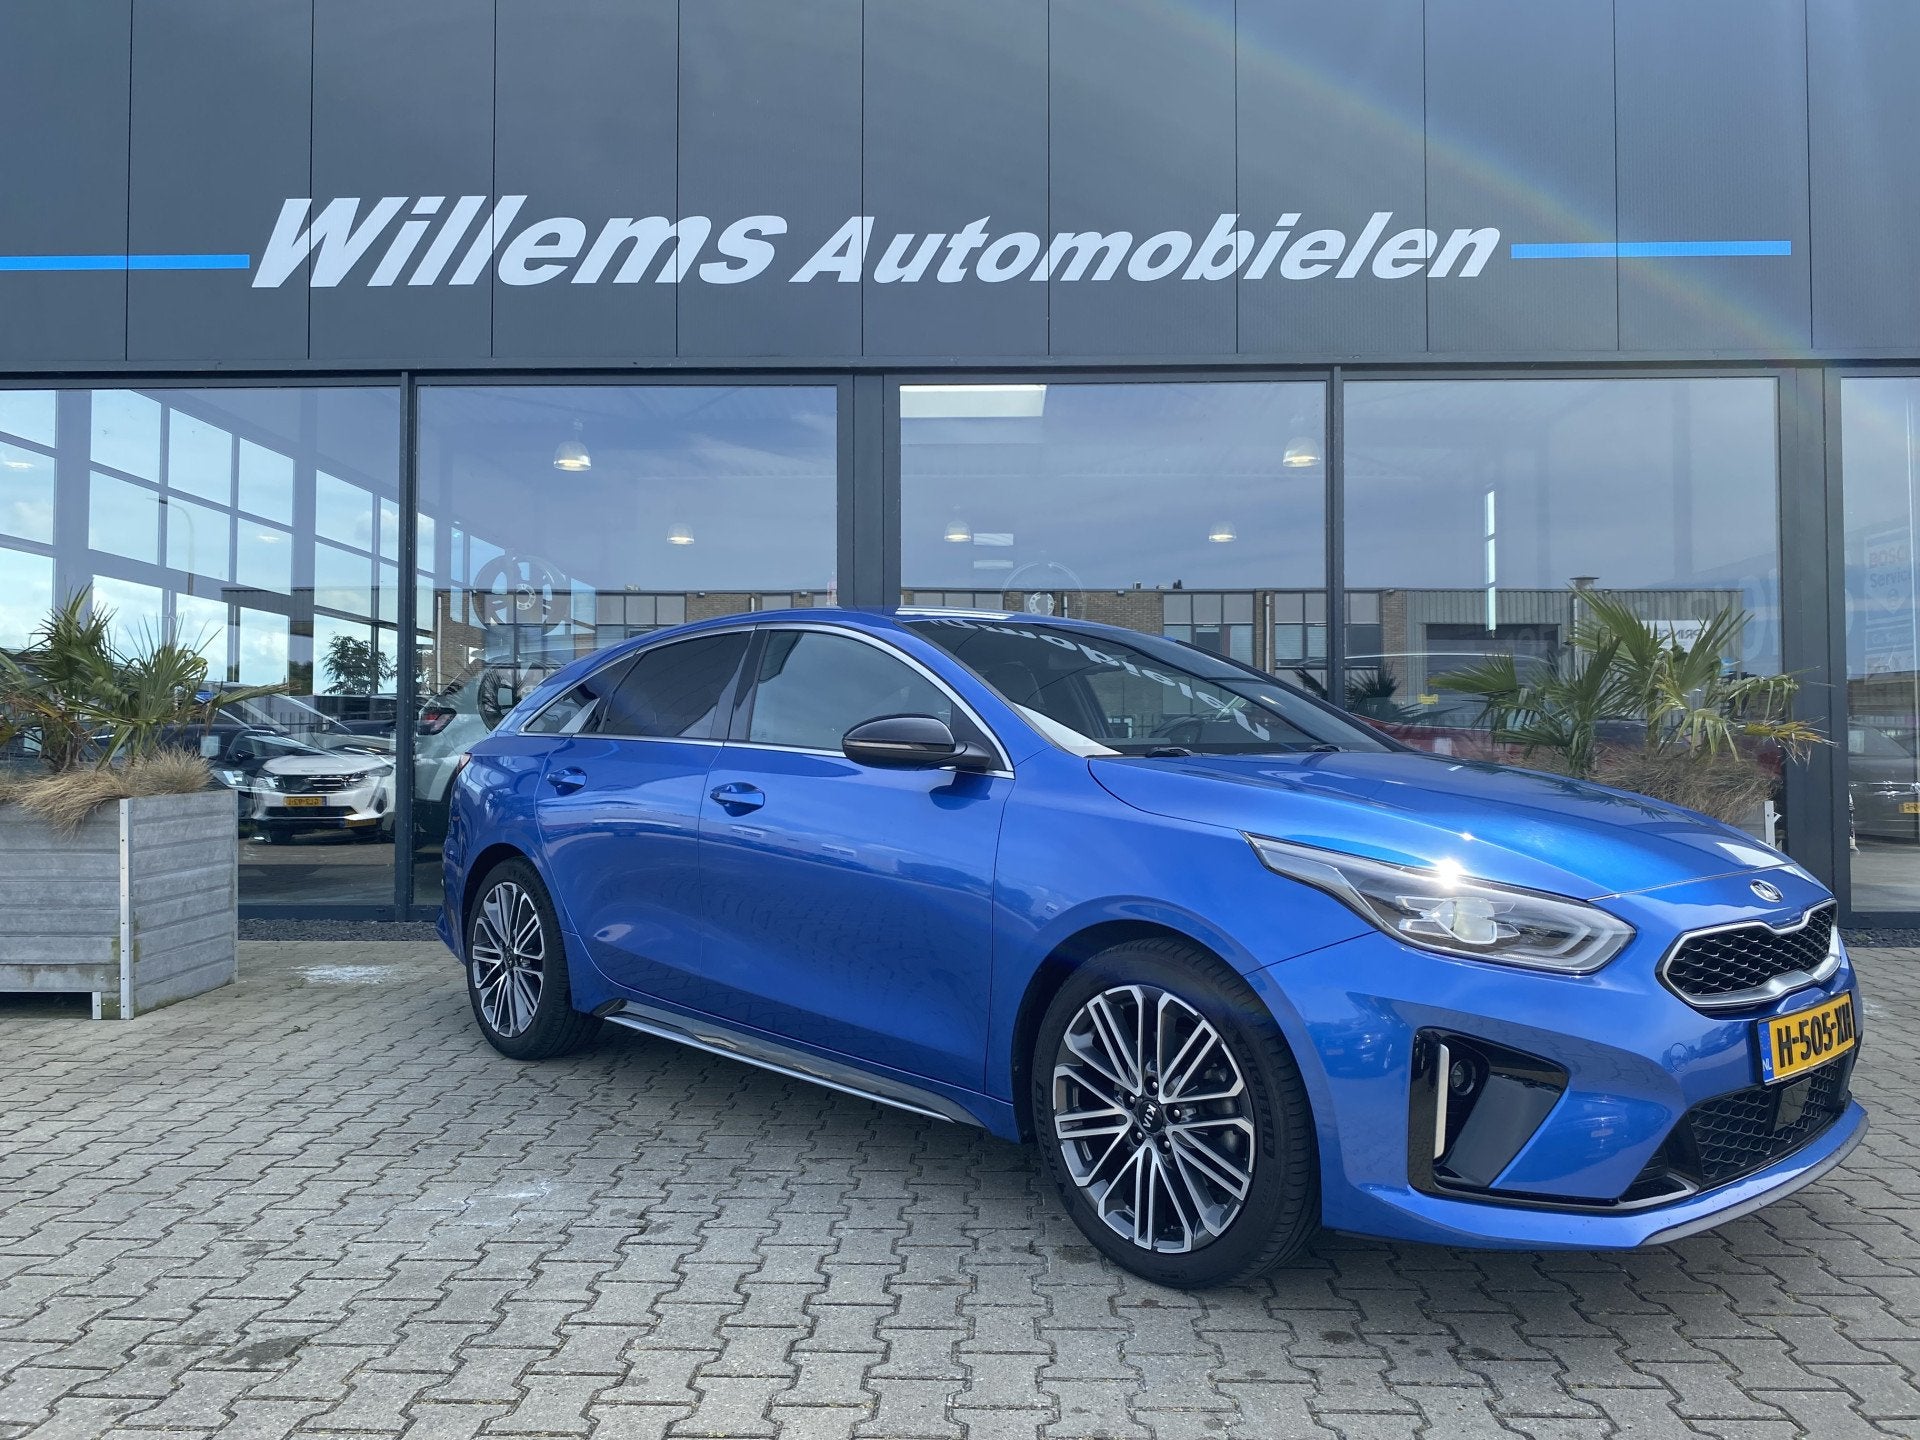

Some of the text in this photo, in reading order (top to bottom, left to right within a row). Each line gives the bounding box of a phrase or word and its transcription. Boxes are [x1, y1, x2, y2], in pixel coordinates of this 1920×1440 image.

[252, 195, 1500, 287] Willems Automobielen
[1762, 1057, 1773, 1072] NL
[1142, 1103, 1157, 1128] KIA
